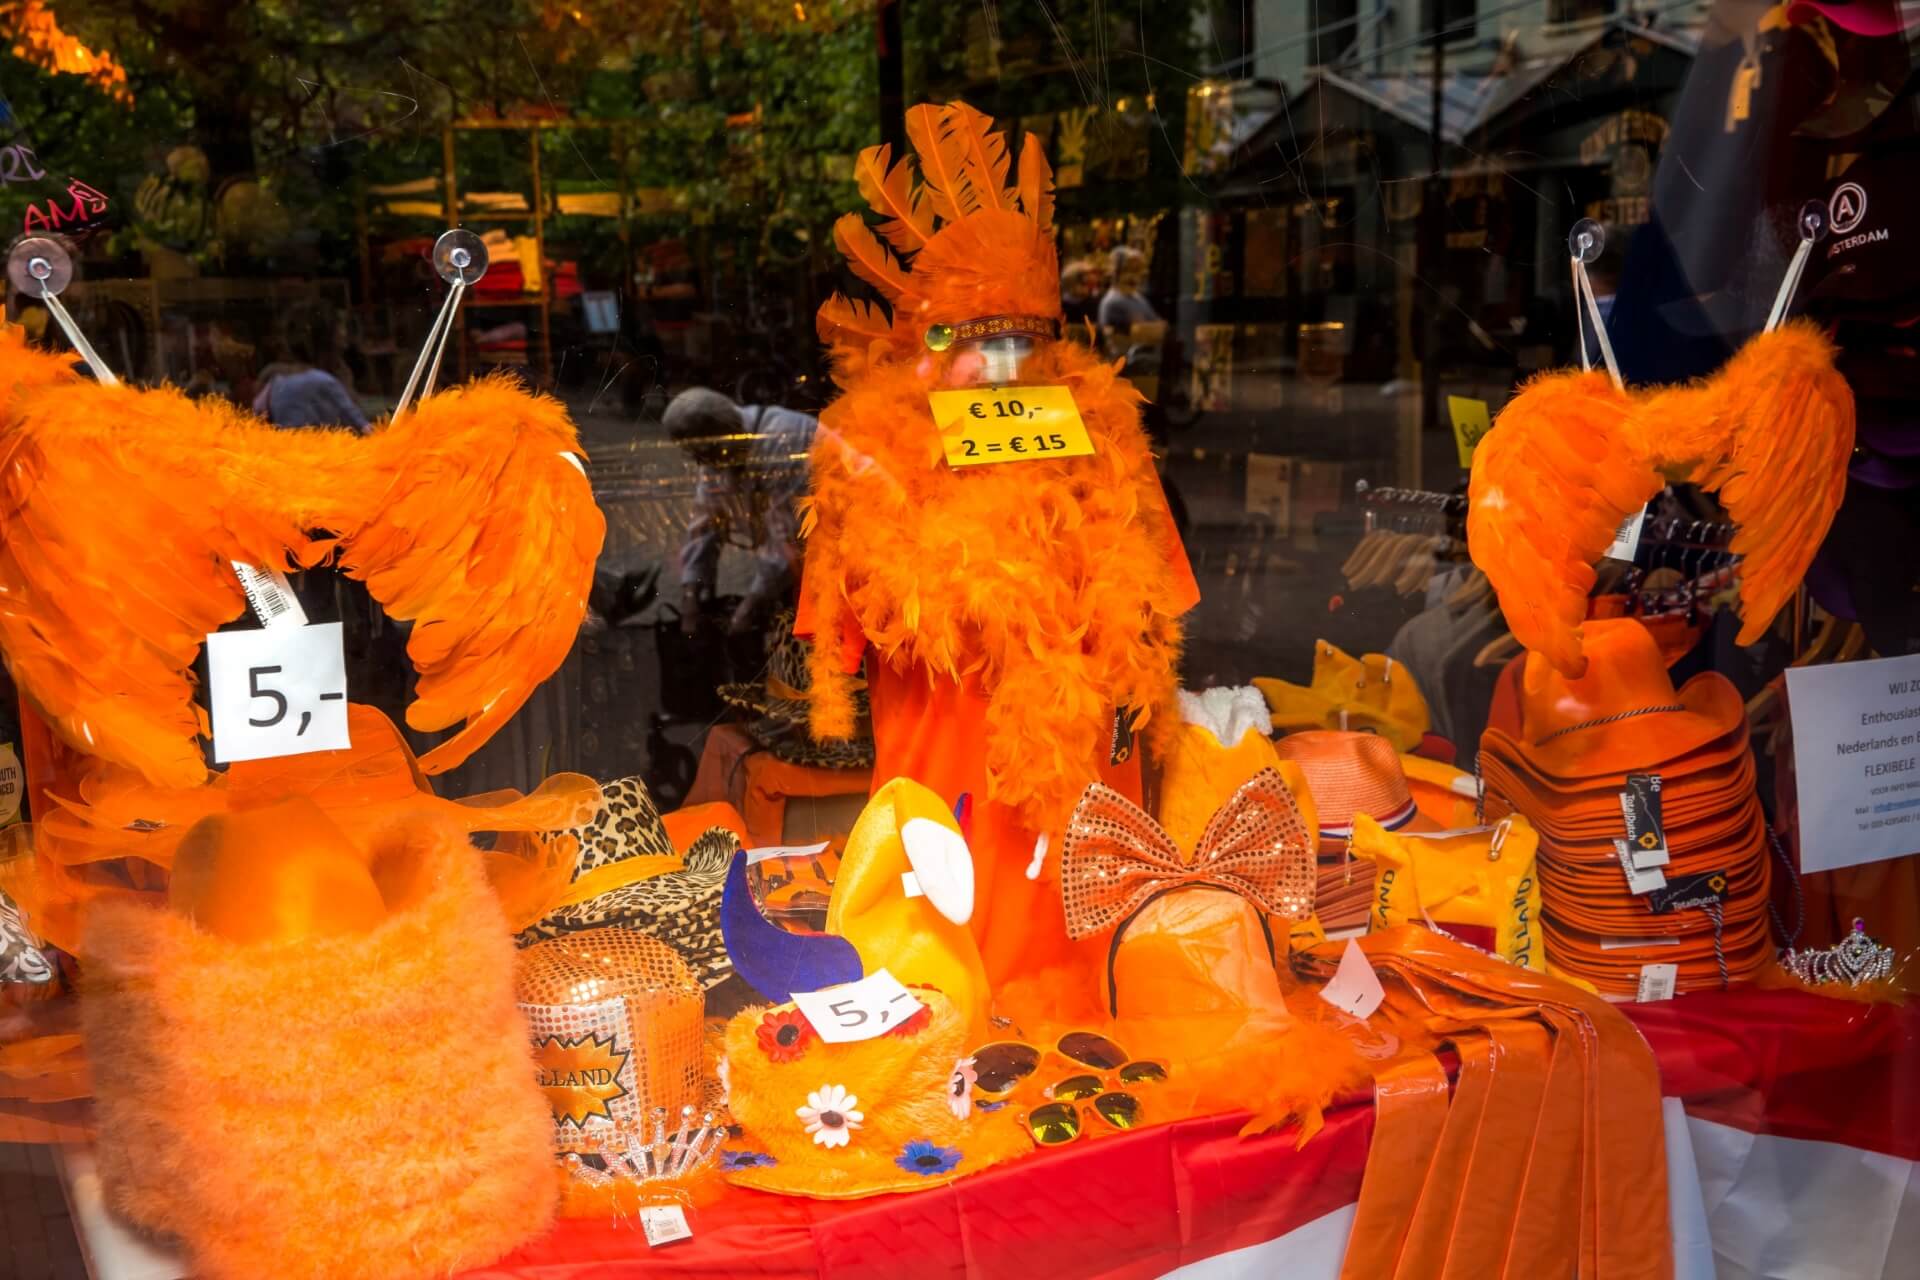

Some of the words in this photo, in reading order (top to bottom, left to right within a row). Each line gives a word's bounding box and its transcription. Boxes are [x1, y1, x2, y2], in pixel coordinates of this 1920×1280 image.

[1828, 228, 1889, 257] STERDAM
[968, 402, 987, 419] €
[993, 400, 1043, 419] 10,-
[962, 439, 980, 457] 2
[986, 442, 1002, 452] =
[1009, 436, 1027, 453] €
[1033, 433, 1067, 451] 15
[248, 665, 343, 736] 5,-
[1837, 735, 1899, 755] Nederlands
[1901, 734, 1914, 746] en
[0, 767, 17, 782] UTH
[1865, 757, 1916, 777] FLEXIBELE
[829, 992, 908, 1028] 5,-
[538, 1067, 613, 1088] LLAND
